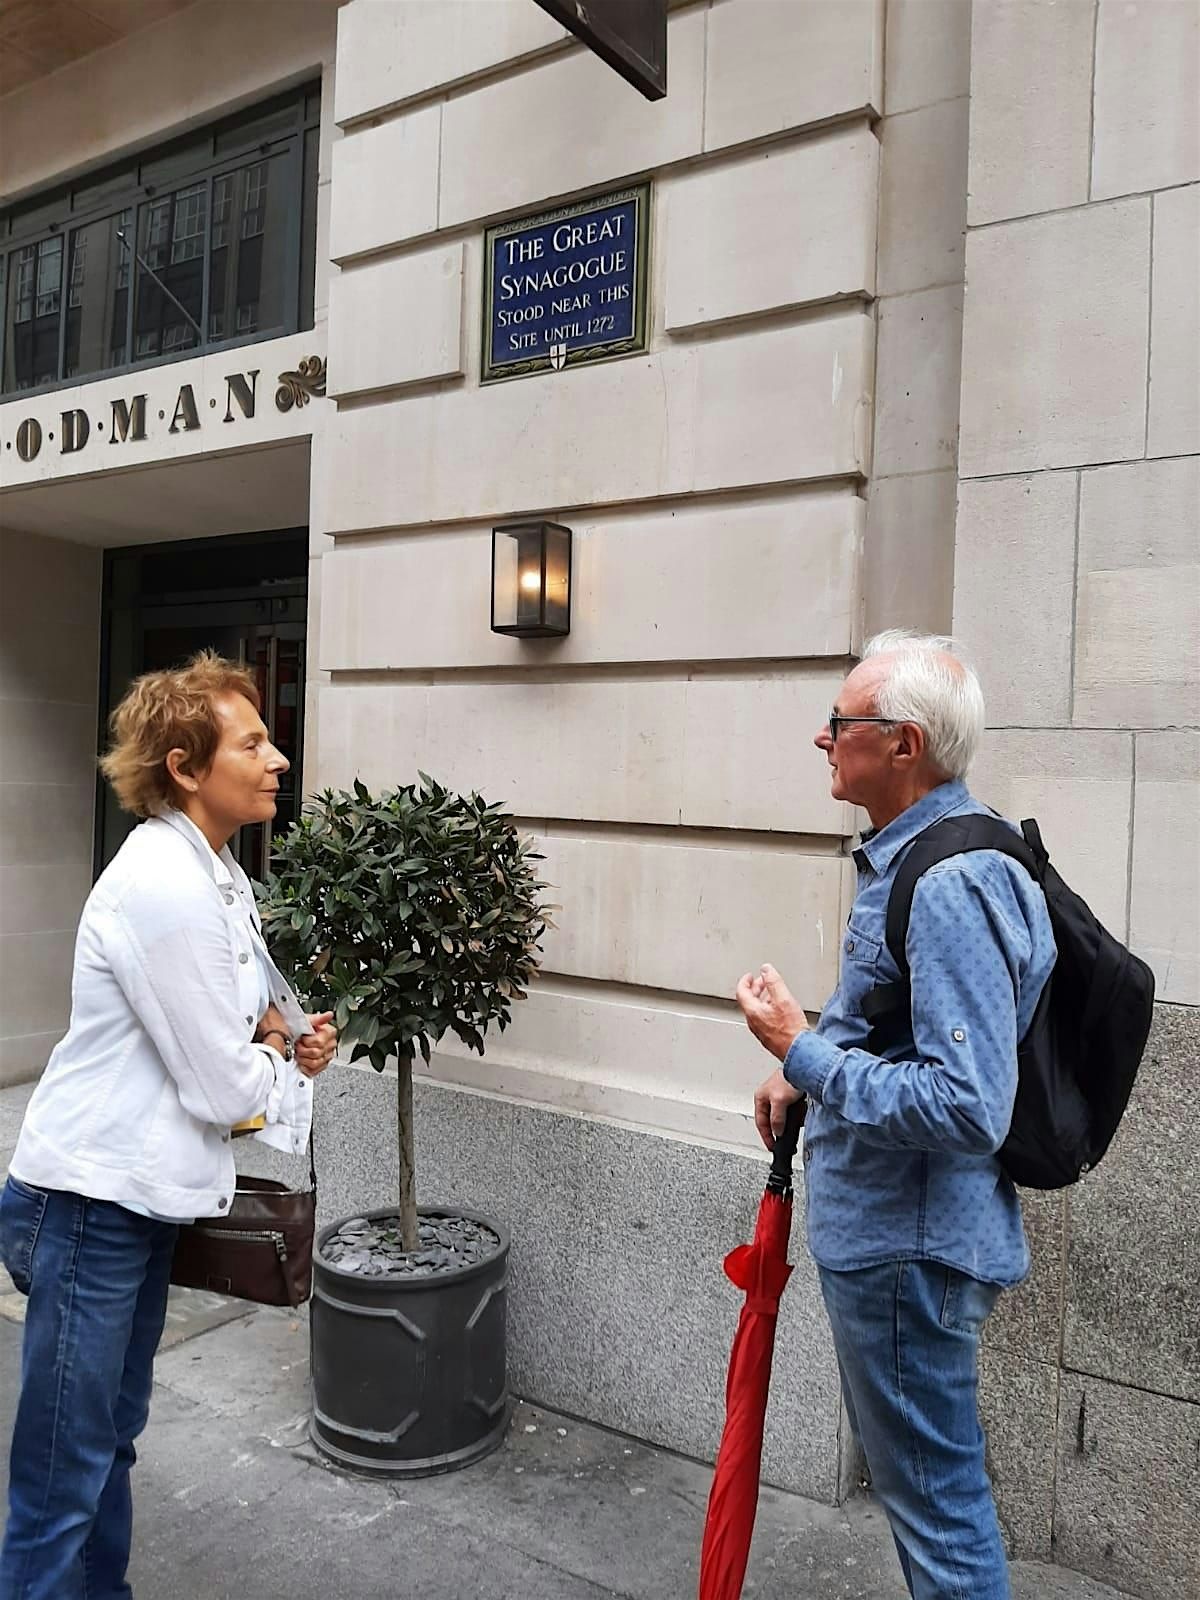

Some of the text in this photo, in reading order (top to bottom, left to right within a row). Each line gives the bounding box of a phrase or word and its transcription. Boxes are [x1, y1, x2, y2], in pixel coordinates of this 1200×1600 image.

[504, 214, 625, 265] THE GREAT
[501, 250, 626, 300] SYNAGOGUE
[497, 283, 630, 328] STOOD NEAR THIS
[509, 315, 615, 350] SITE UNTIL 1272
